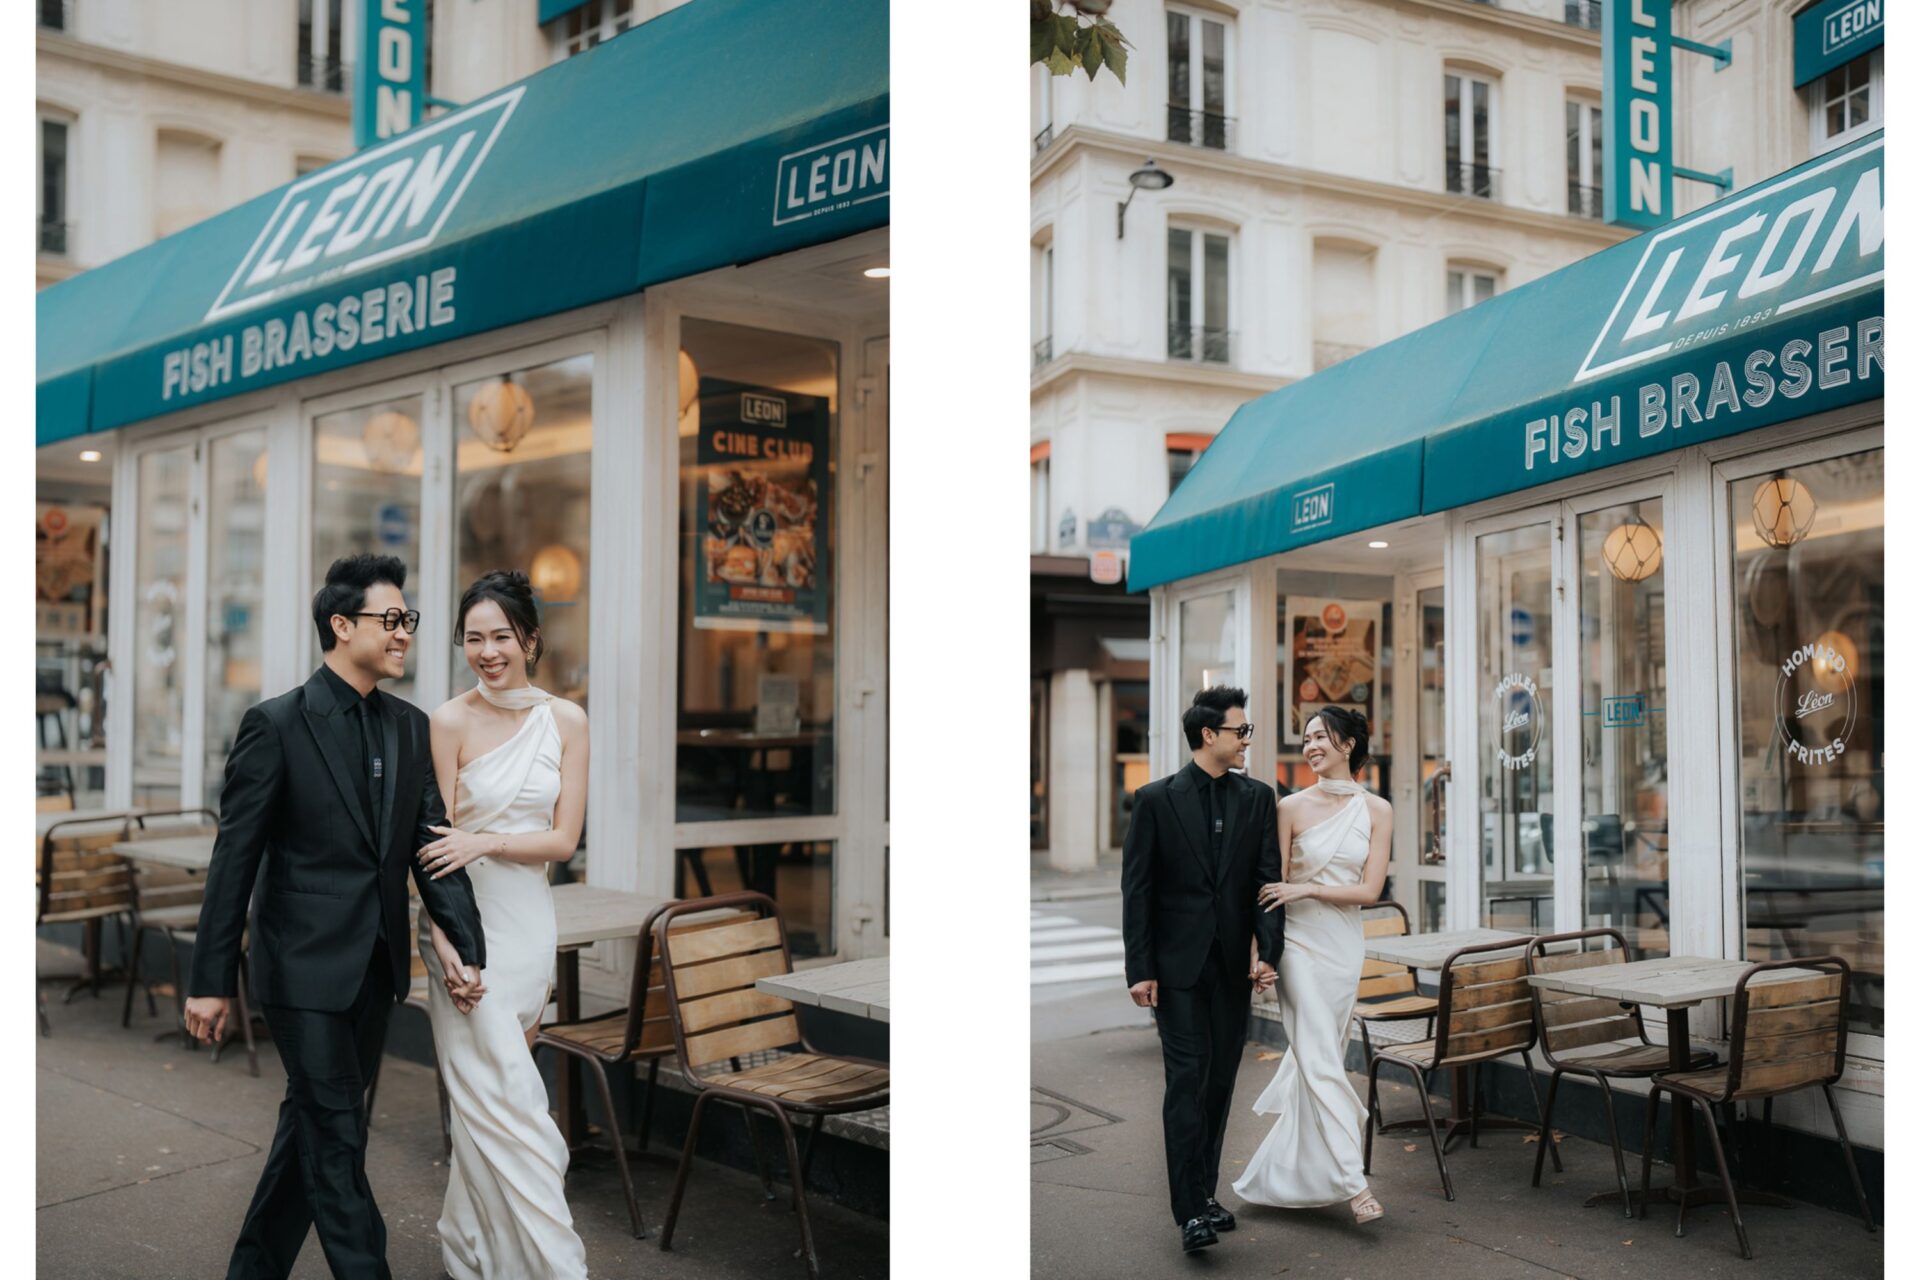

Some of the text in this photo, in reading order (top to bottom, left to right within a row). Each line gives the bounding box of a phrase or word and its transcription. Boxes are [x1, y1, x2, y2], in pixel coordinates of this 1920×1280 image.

[162, 266, 457, 400] FISH BRASSERIE
[1674, 308, 1773, 349] DEPUIS 1893
[1525, 316, 1884, 470] FISH BRASSER
[1782, 643, 1846, 677] HOMARD
[1495, 672, 1537, 698] MOULES
[1497, 747, 1535, 770] FRITES
[1788, 737, 1845, 765] FRITES
